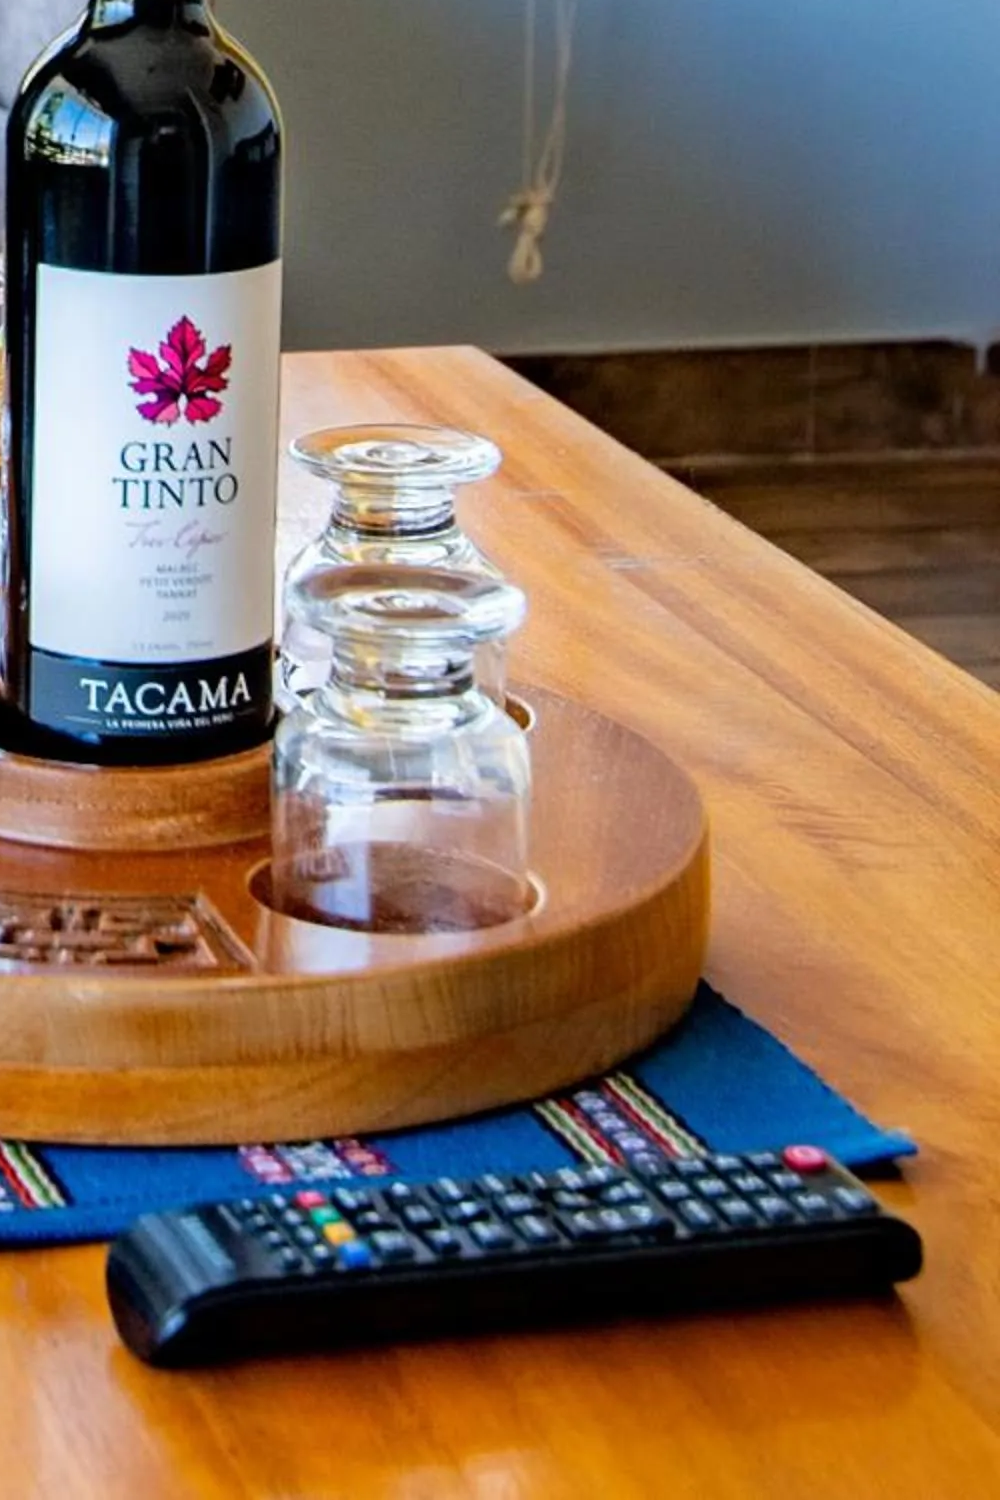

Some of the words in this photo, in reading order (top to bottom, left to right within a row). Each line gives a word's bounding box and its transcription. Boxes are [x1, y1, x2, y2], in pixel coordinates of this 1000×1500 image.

[120, 437, 232, 473] GRAN
[112, 473, 239, 509] TINTO
[80, 672, 251, 715] TACAMA
[106, 719, 119, 729] LA
